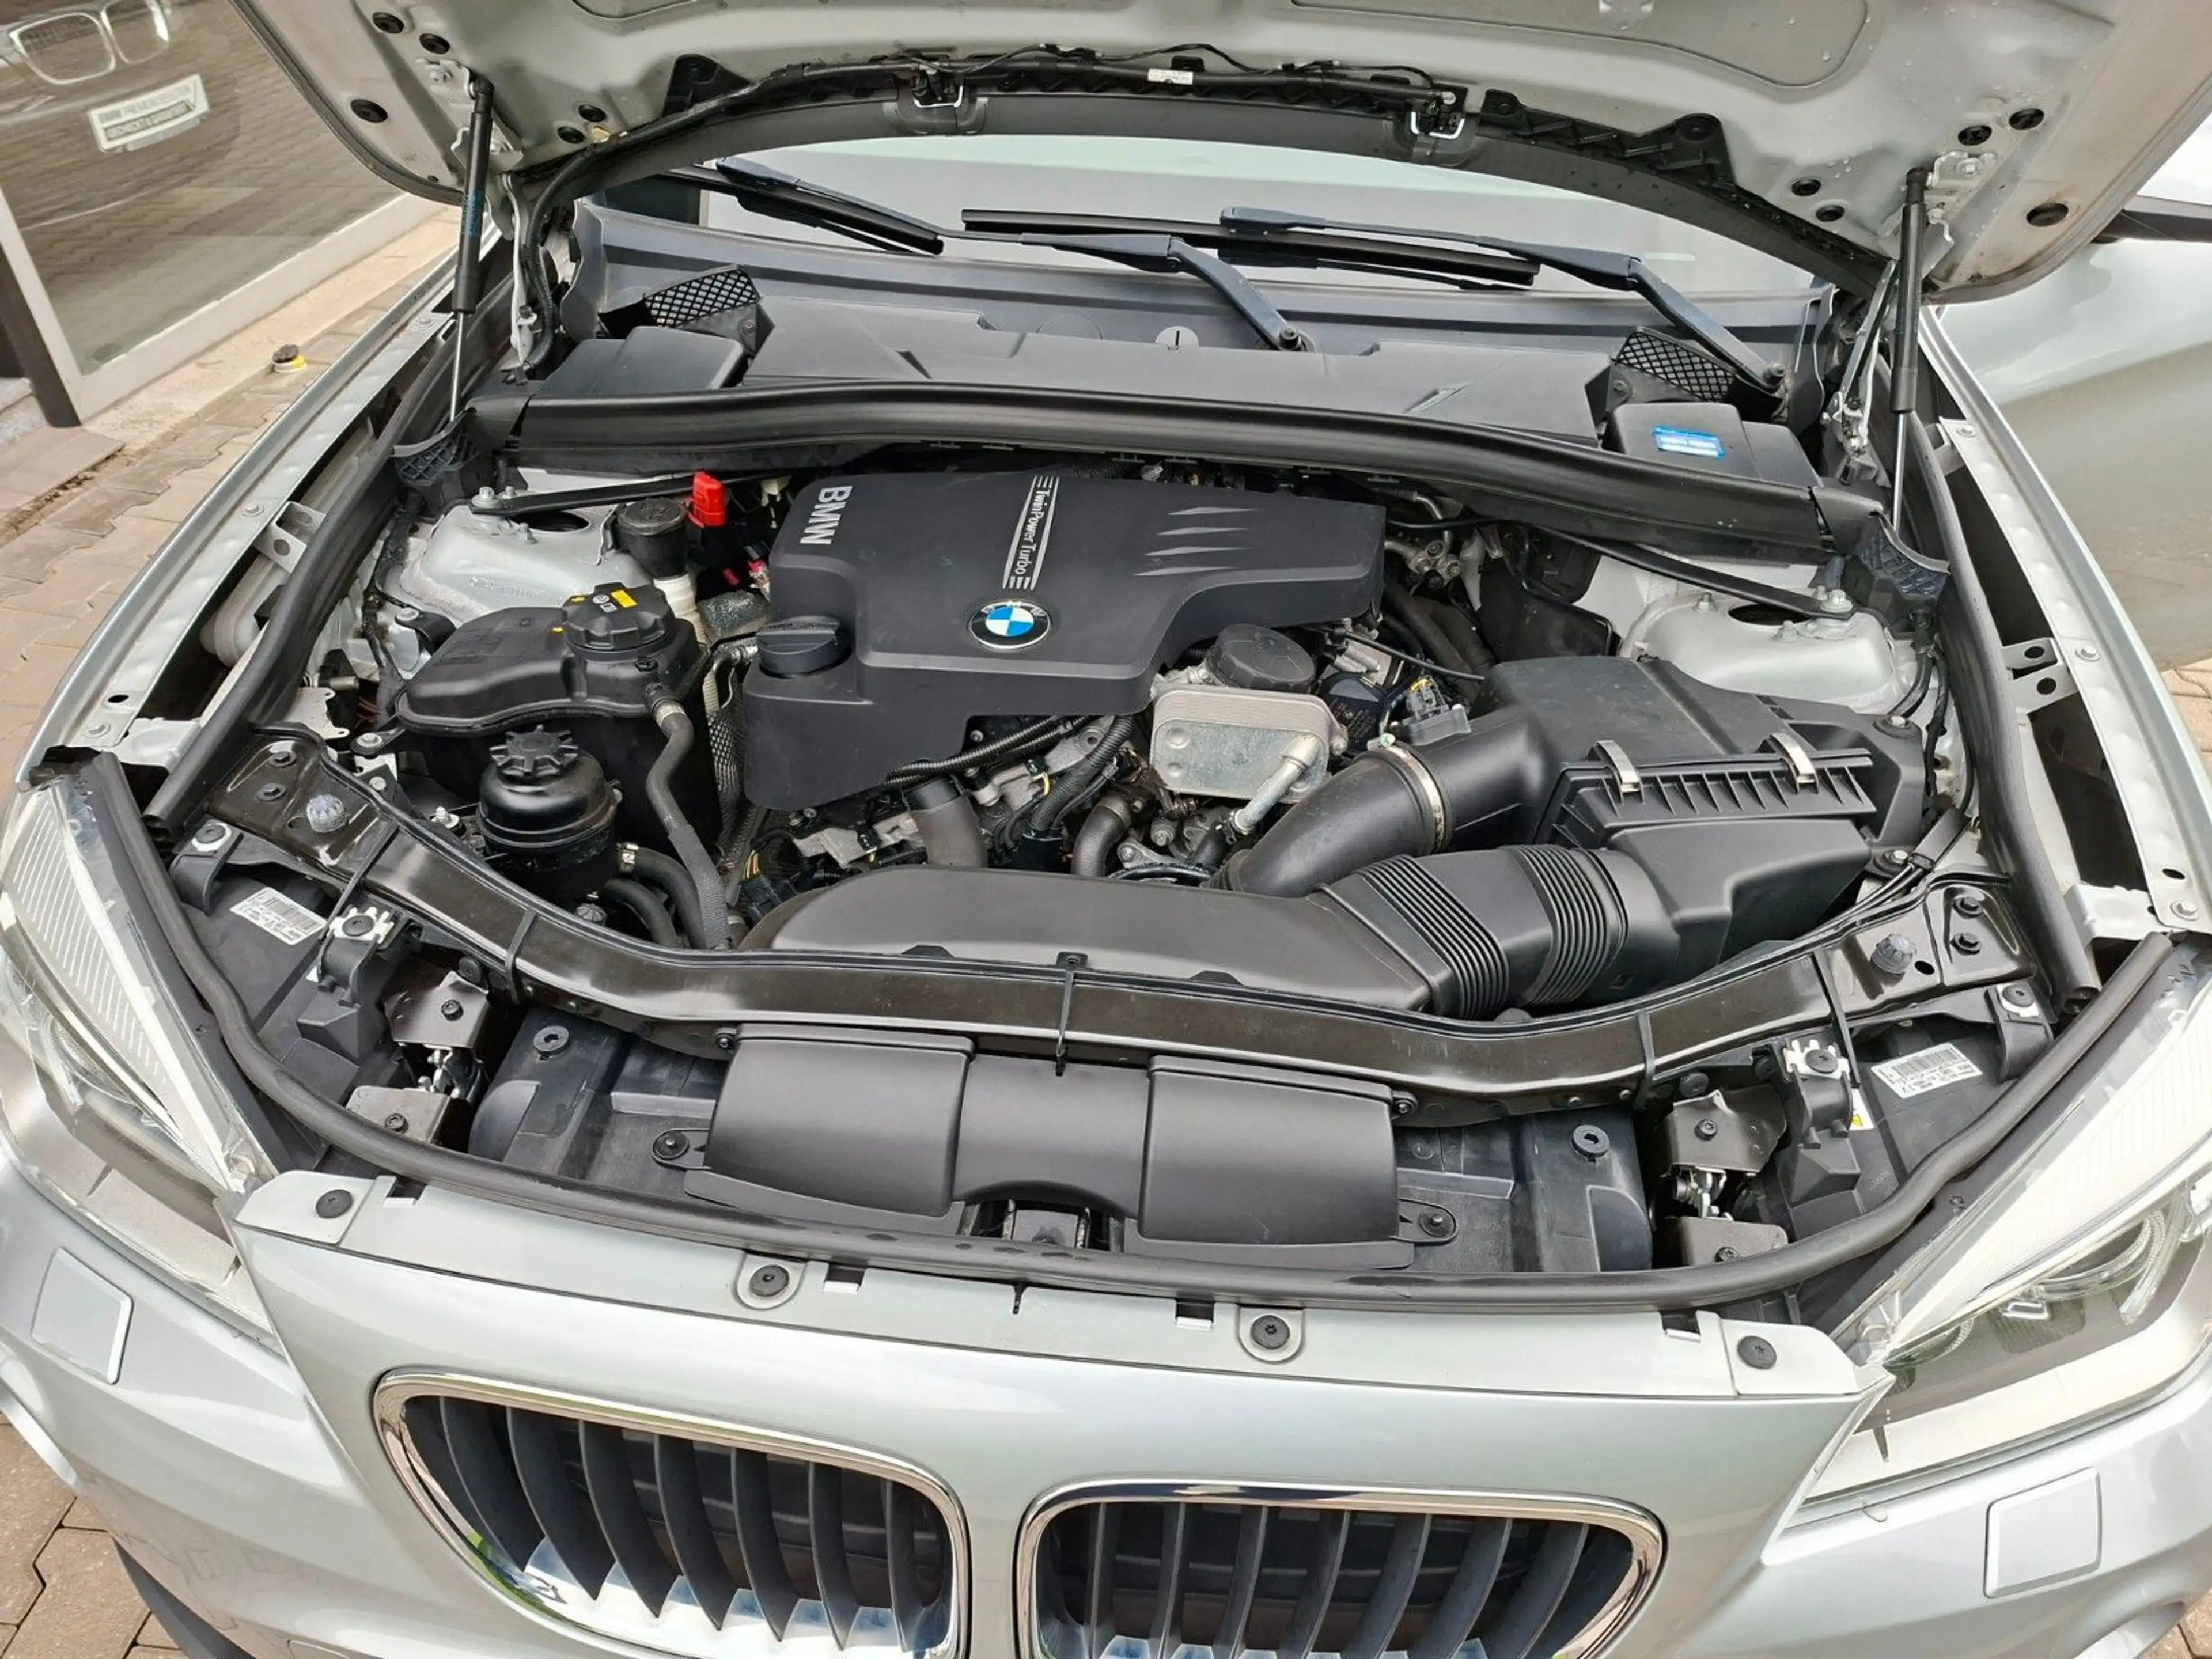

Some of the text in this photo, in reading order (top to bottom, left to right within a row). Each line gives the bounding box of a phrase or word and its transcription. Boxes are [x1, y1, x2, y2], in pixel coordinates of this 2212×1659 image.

[800, 486, 853, 544] BMW
[1015, 490, 1050, 575] TwinPower Turbo
